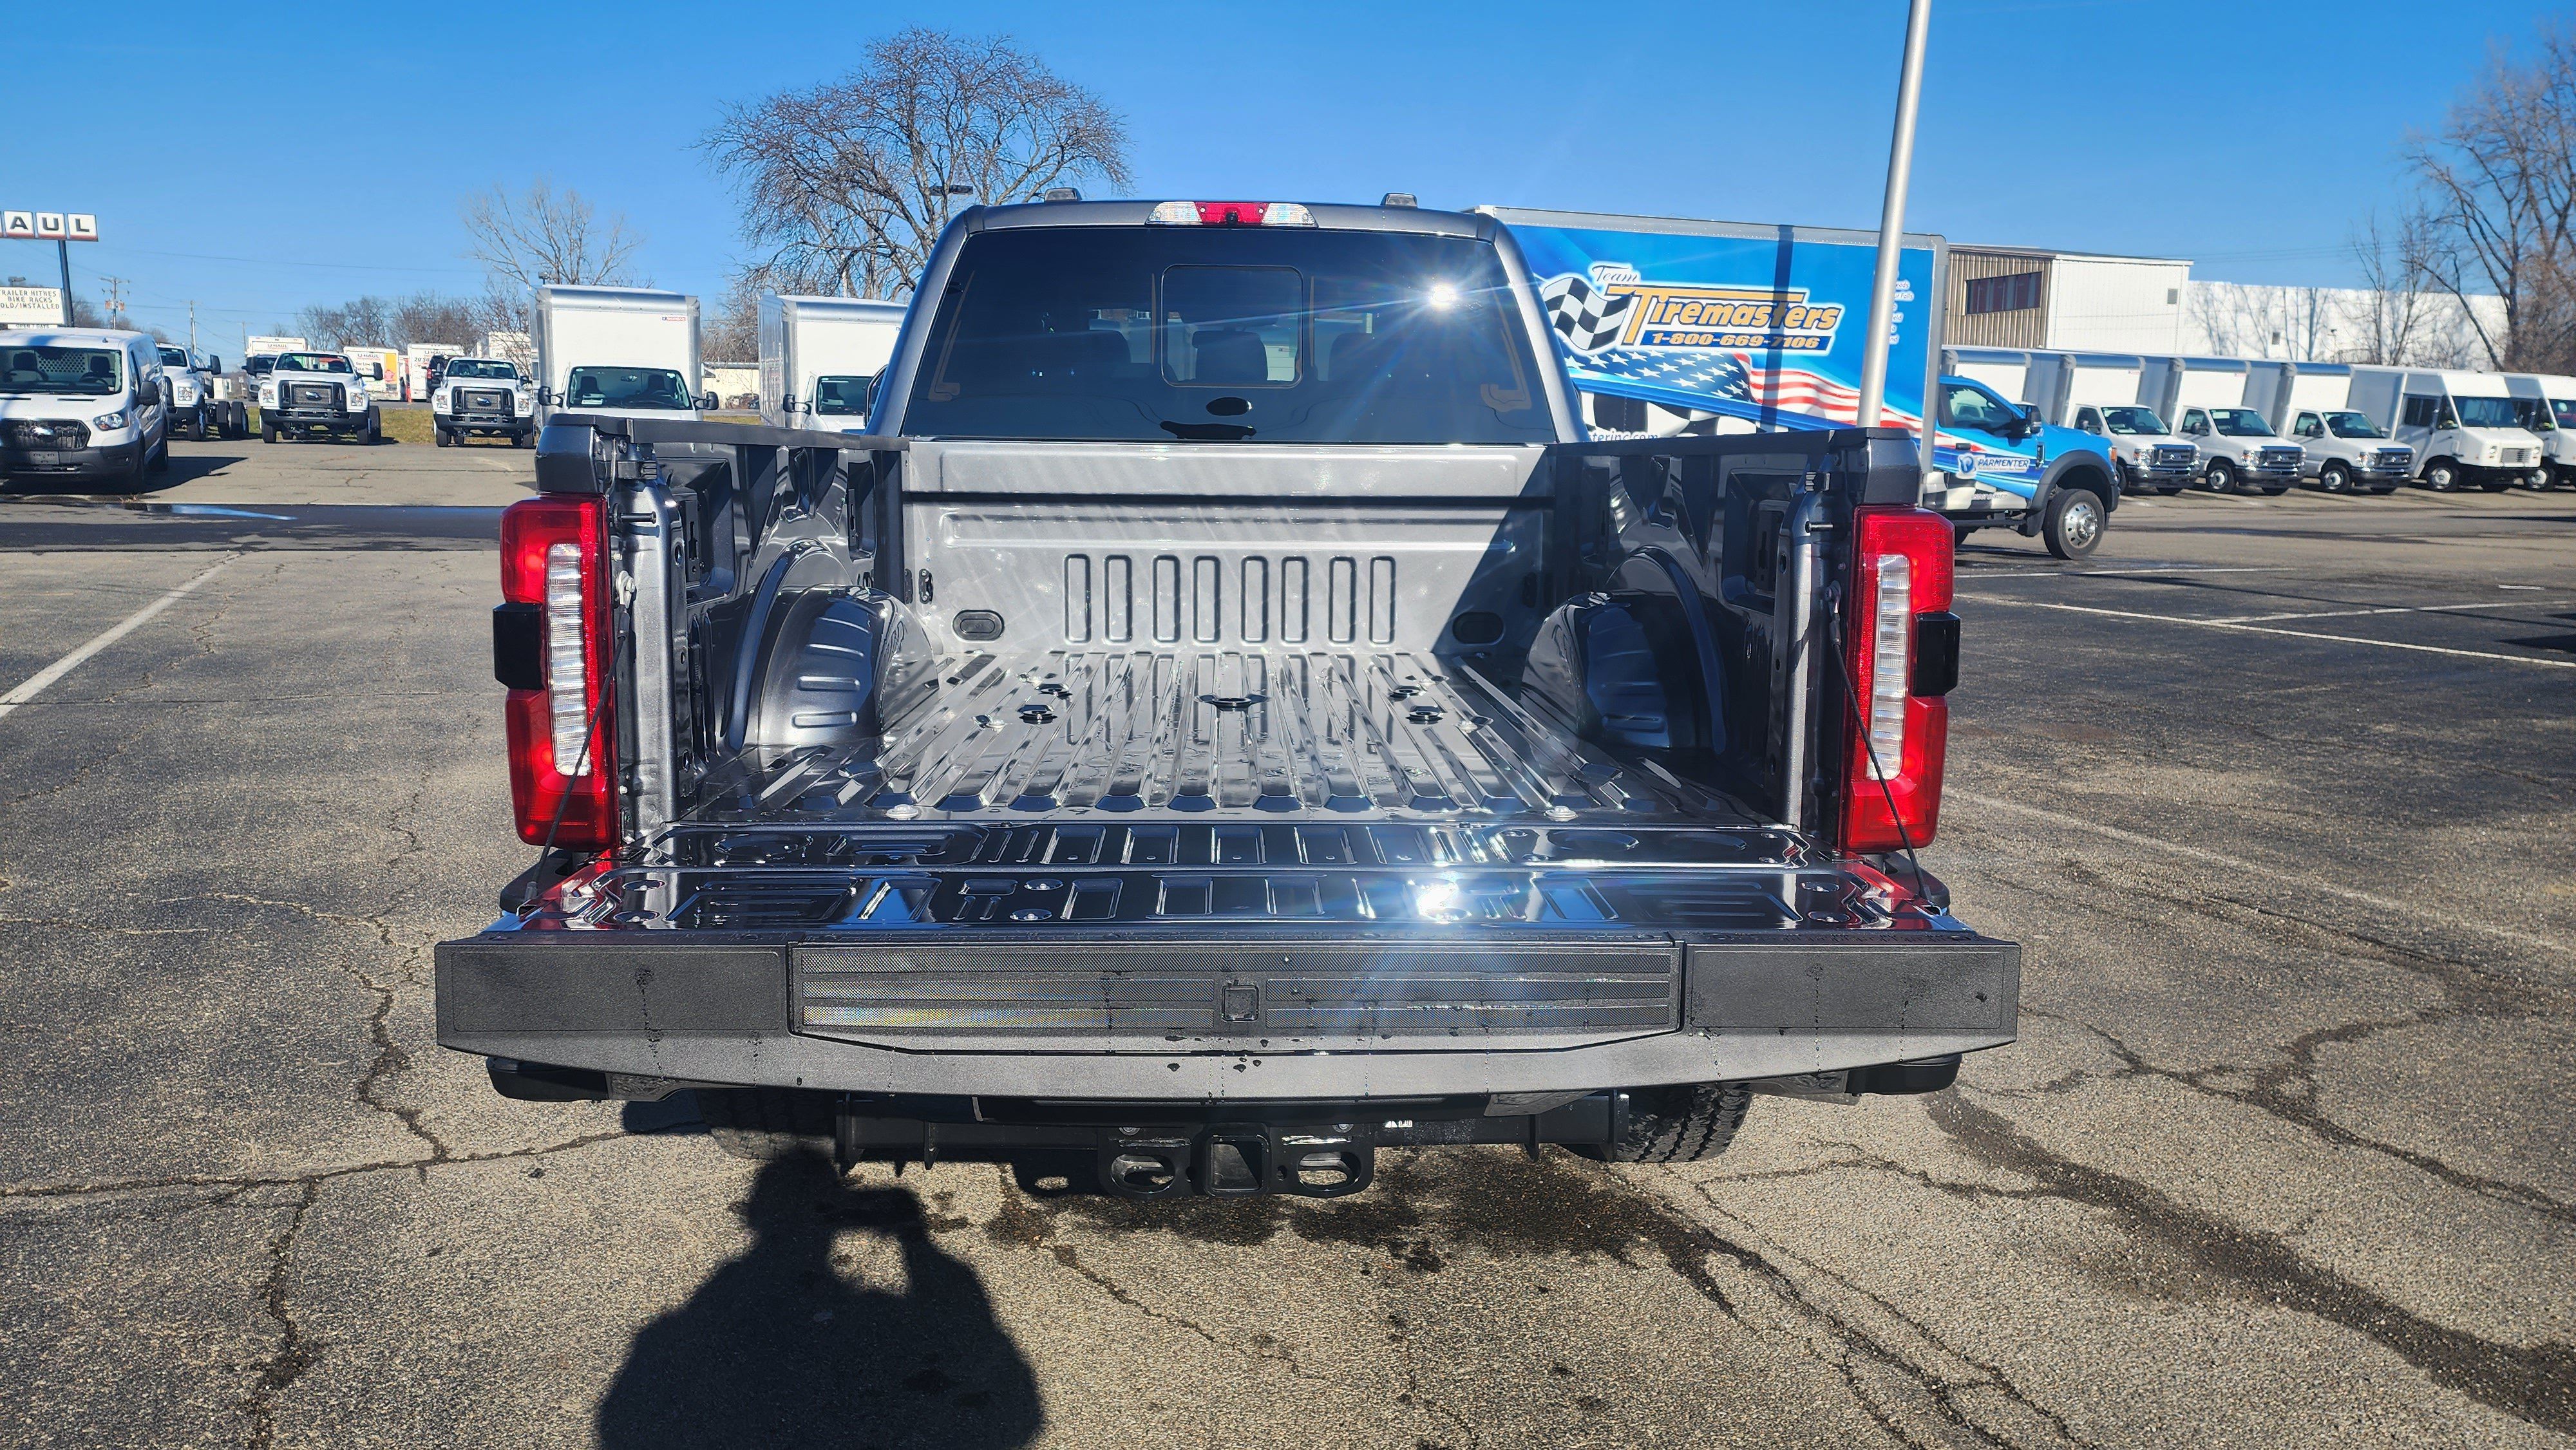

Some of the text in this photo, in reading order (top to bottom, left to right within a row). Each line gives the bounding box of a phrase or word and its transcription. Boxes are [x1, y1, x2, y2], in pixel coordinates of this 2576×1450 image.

[10, 216, 90, 232] AUL
[1592, 265, 1638, 283] Team
[1605, 283, 1842, 346] Tiremasters
[1653, 332, 1820, 348] 1-800-669-7106
[1978, 458, 2029, 467] PARMENTER
